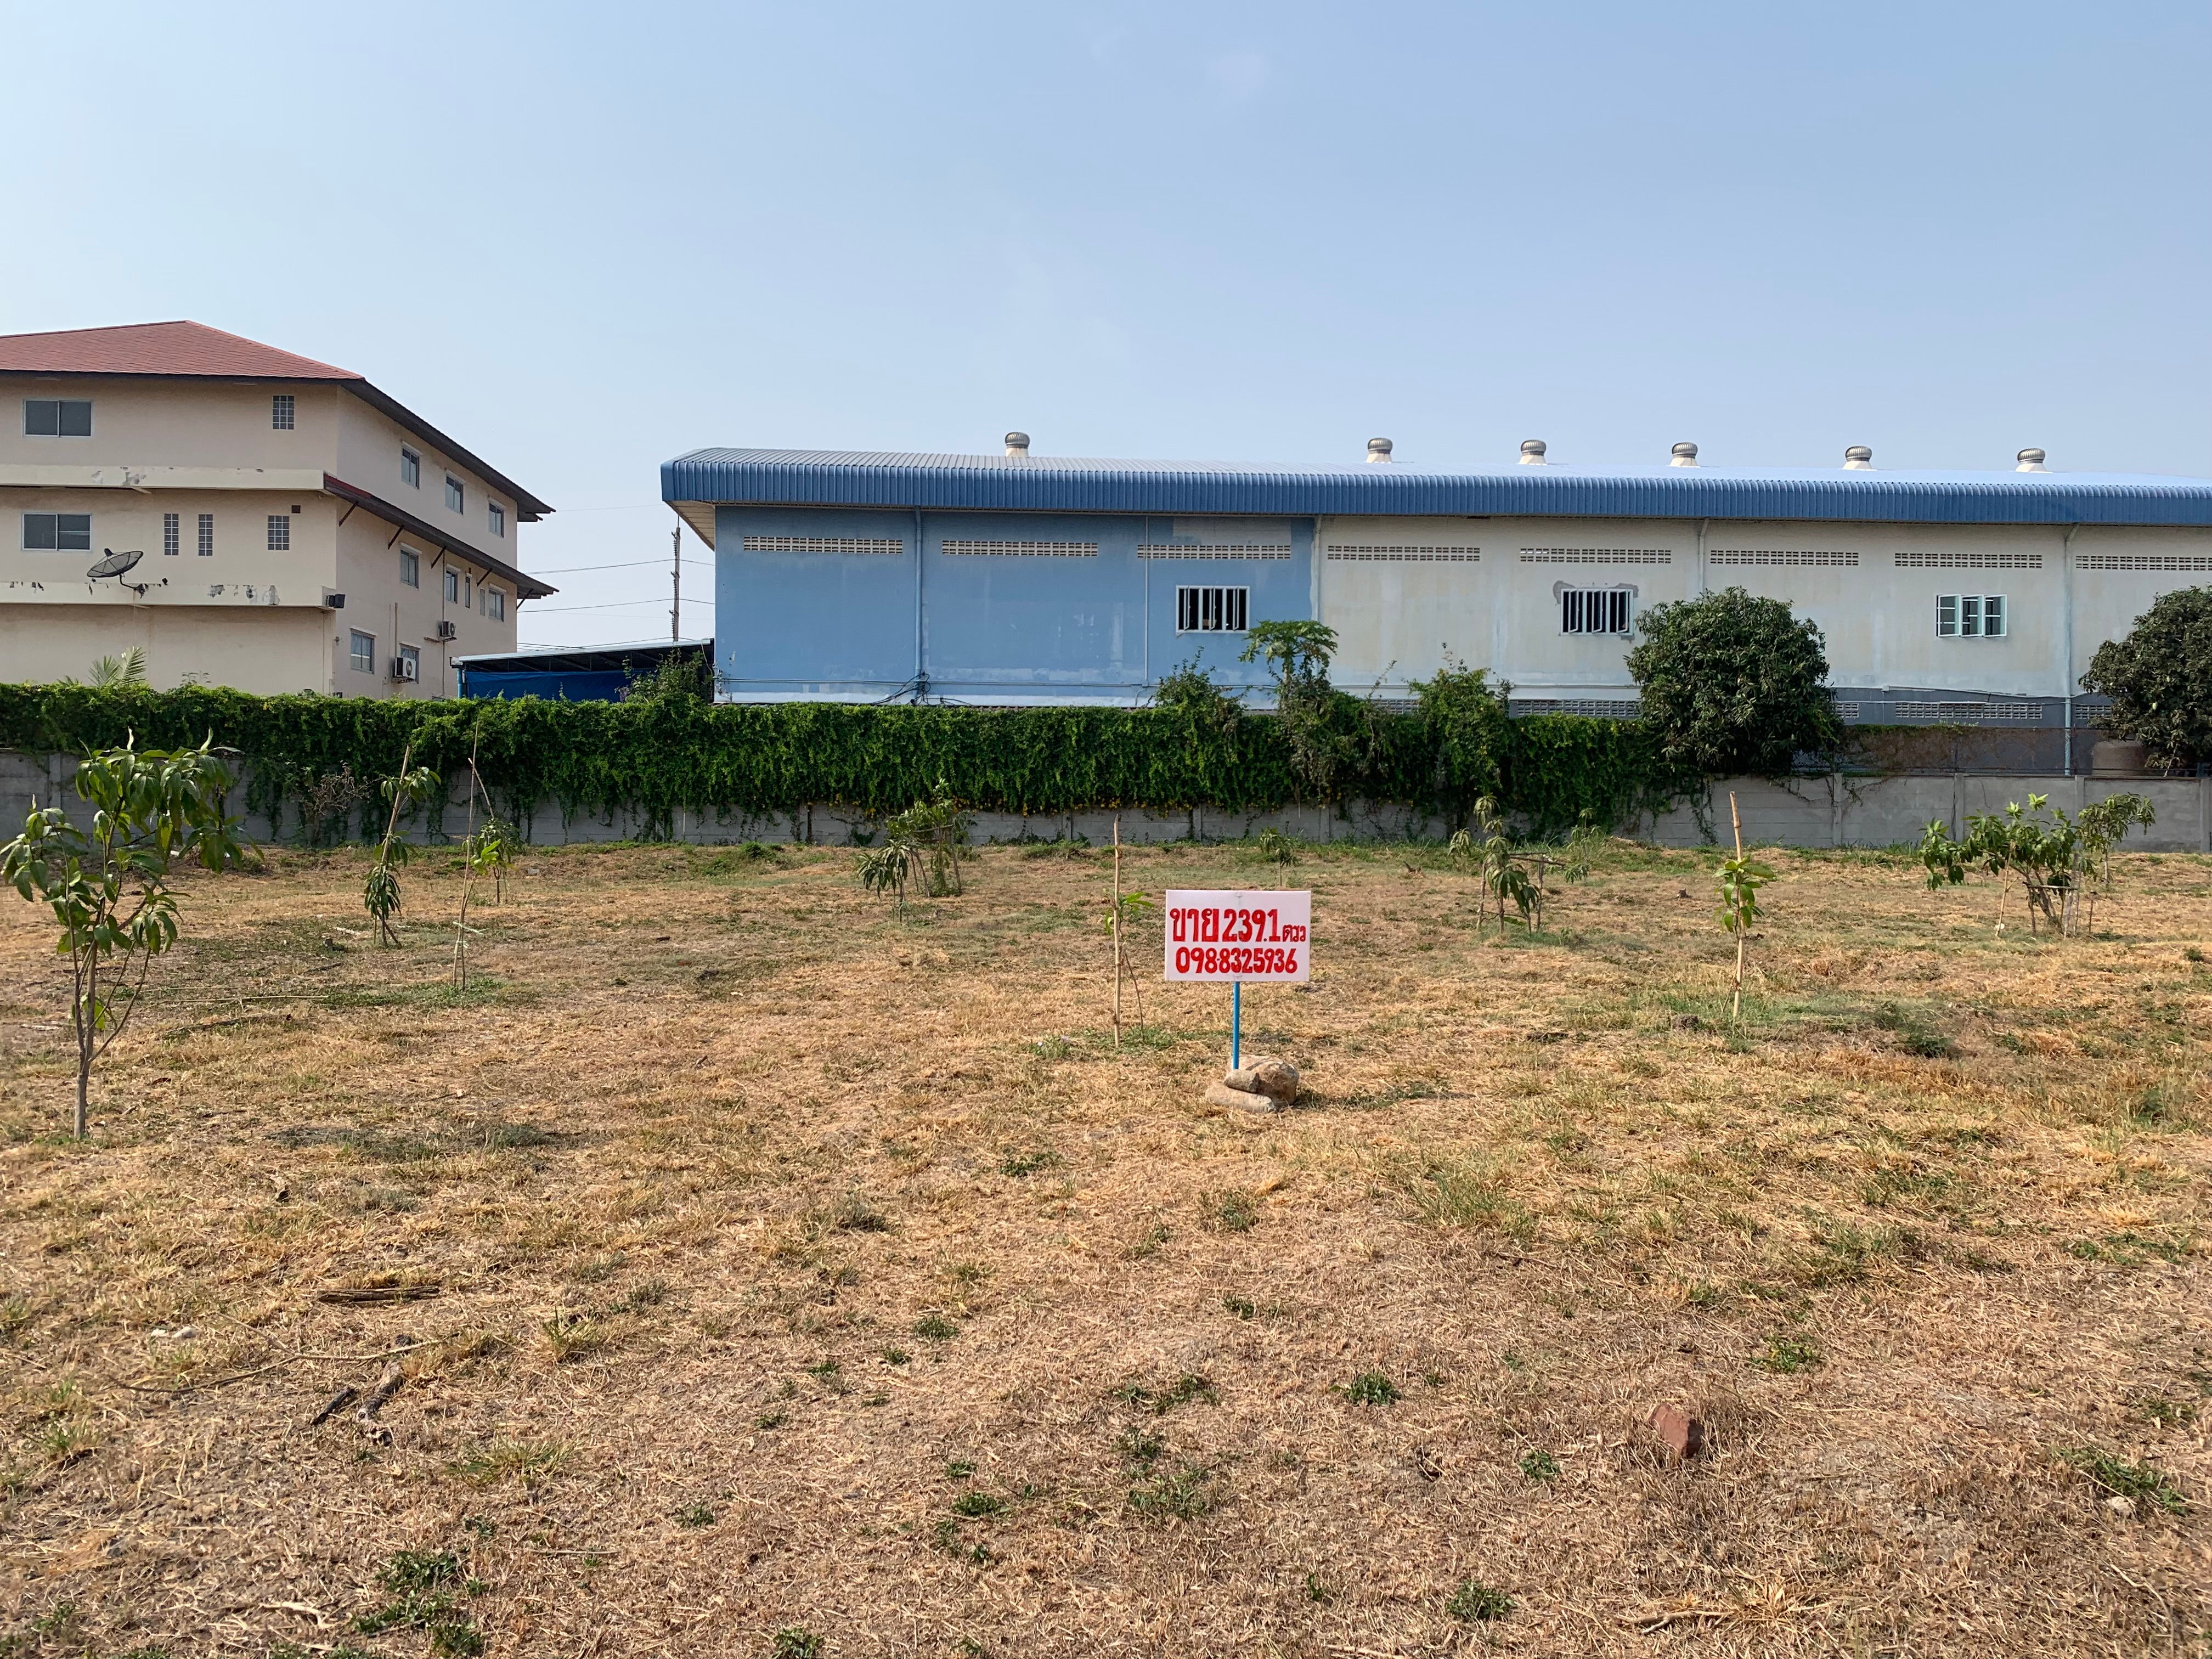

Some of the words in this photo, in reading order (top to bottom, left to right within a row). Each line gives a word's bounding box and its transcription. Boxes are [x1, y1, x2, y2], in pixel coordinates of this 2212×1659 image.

[1170, 908, 1220, 943] ขาย
[1222, 909, 1280, 943] 239.1
[1176, 946, 1297, 974] 098-8325936
